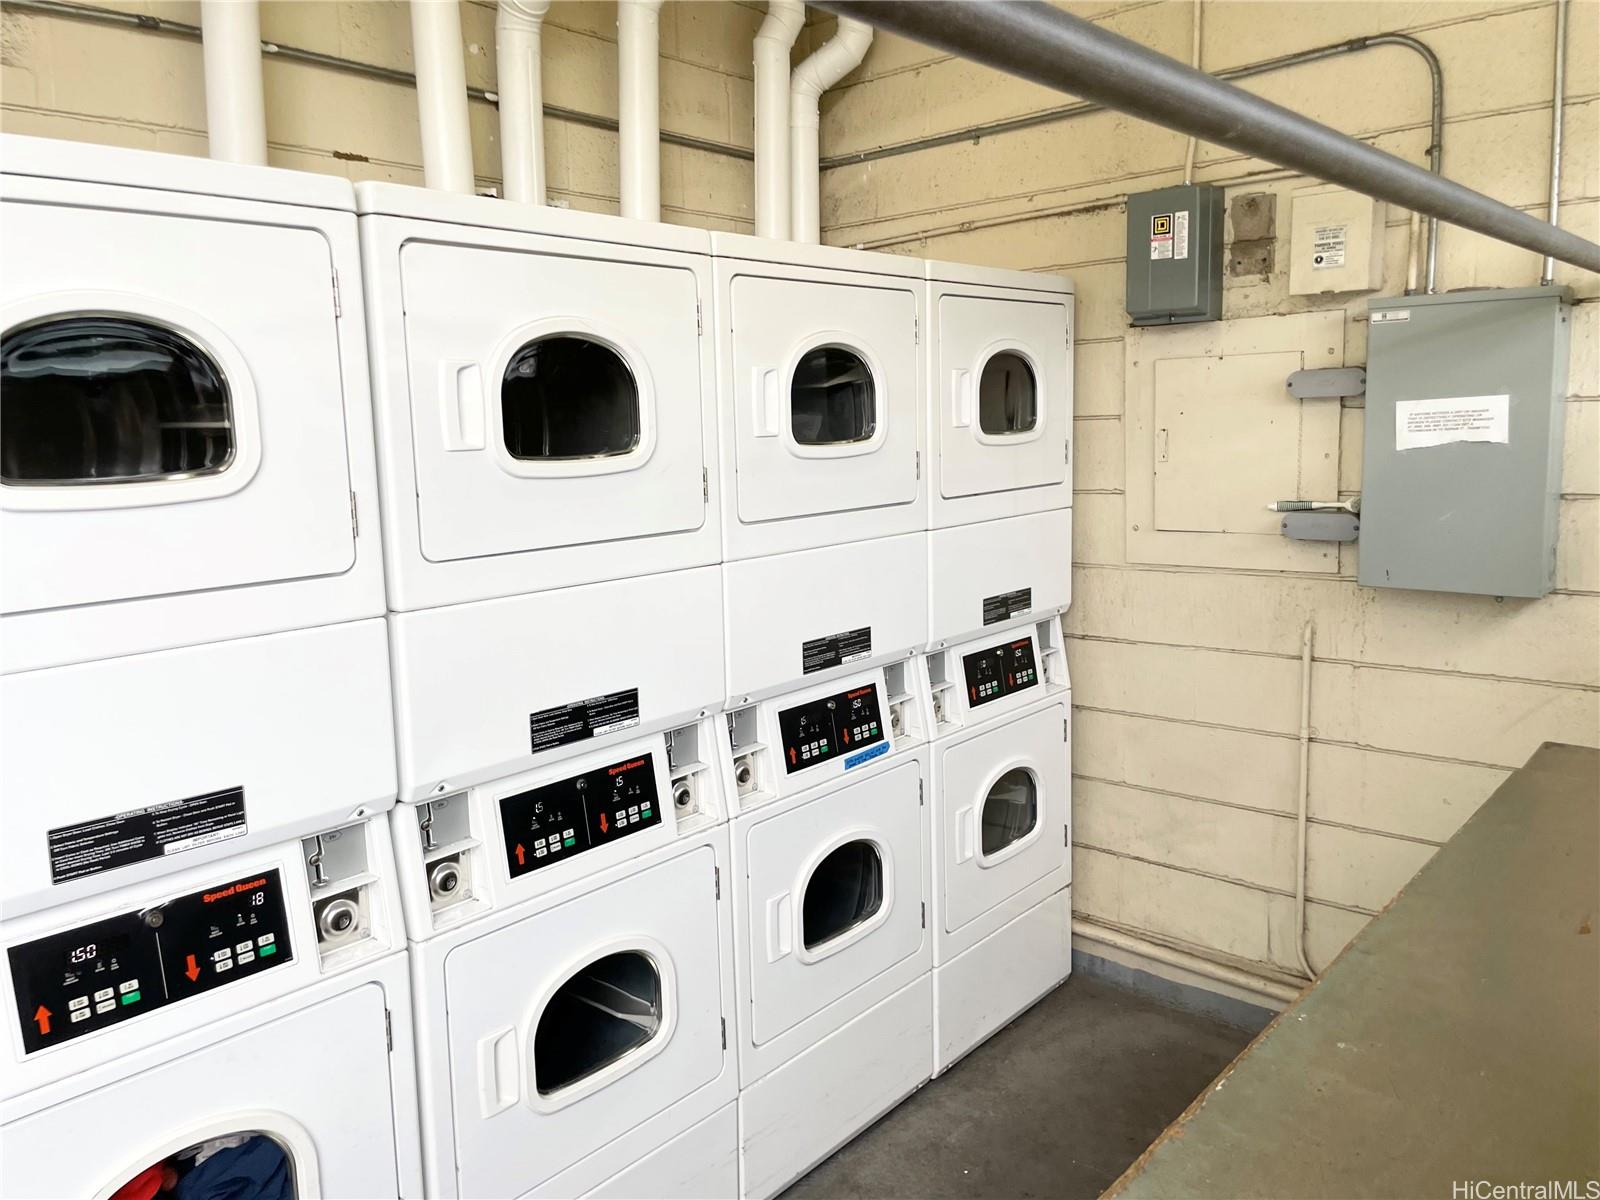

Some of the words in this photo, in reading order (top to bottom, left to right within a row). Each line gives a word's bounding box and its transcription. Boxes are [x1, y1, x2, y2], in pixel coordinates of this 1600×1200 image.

[608, 764, 627, 775] Speed
[627, 760, 645, 769] Queen
[203, 886, 235, 903] Speed
[235, 878, 267, 893] Queen
[252, 891, 264, 906] 18
